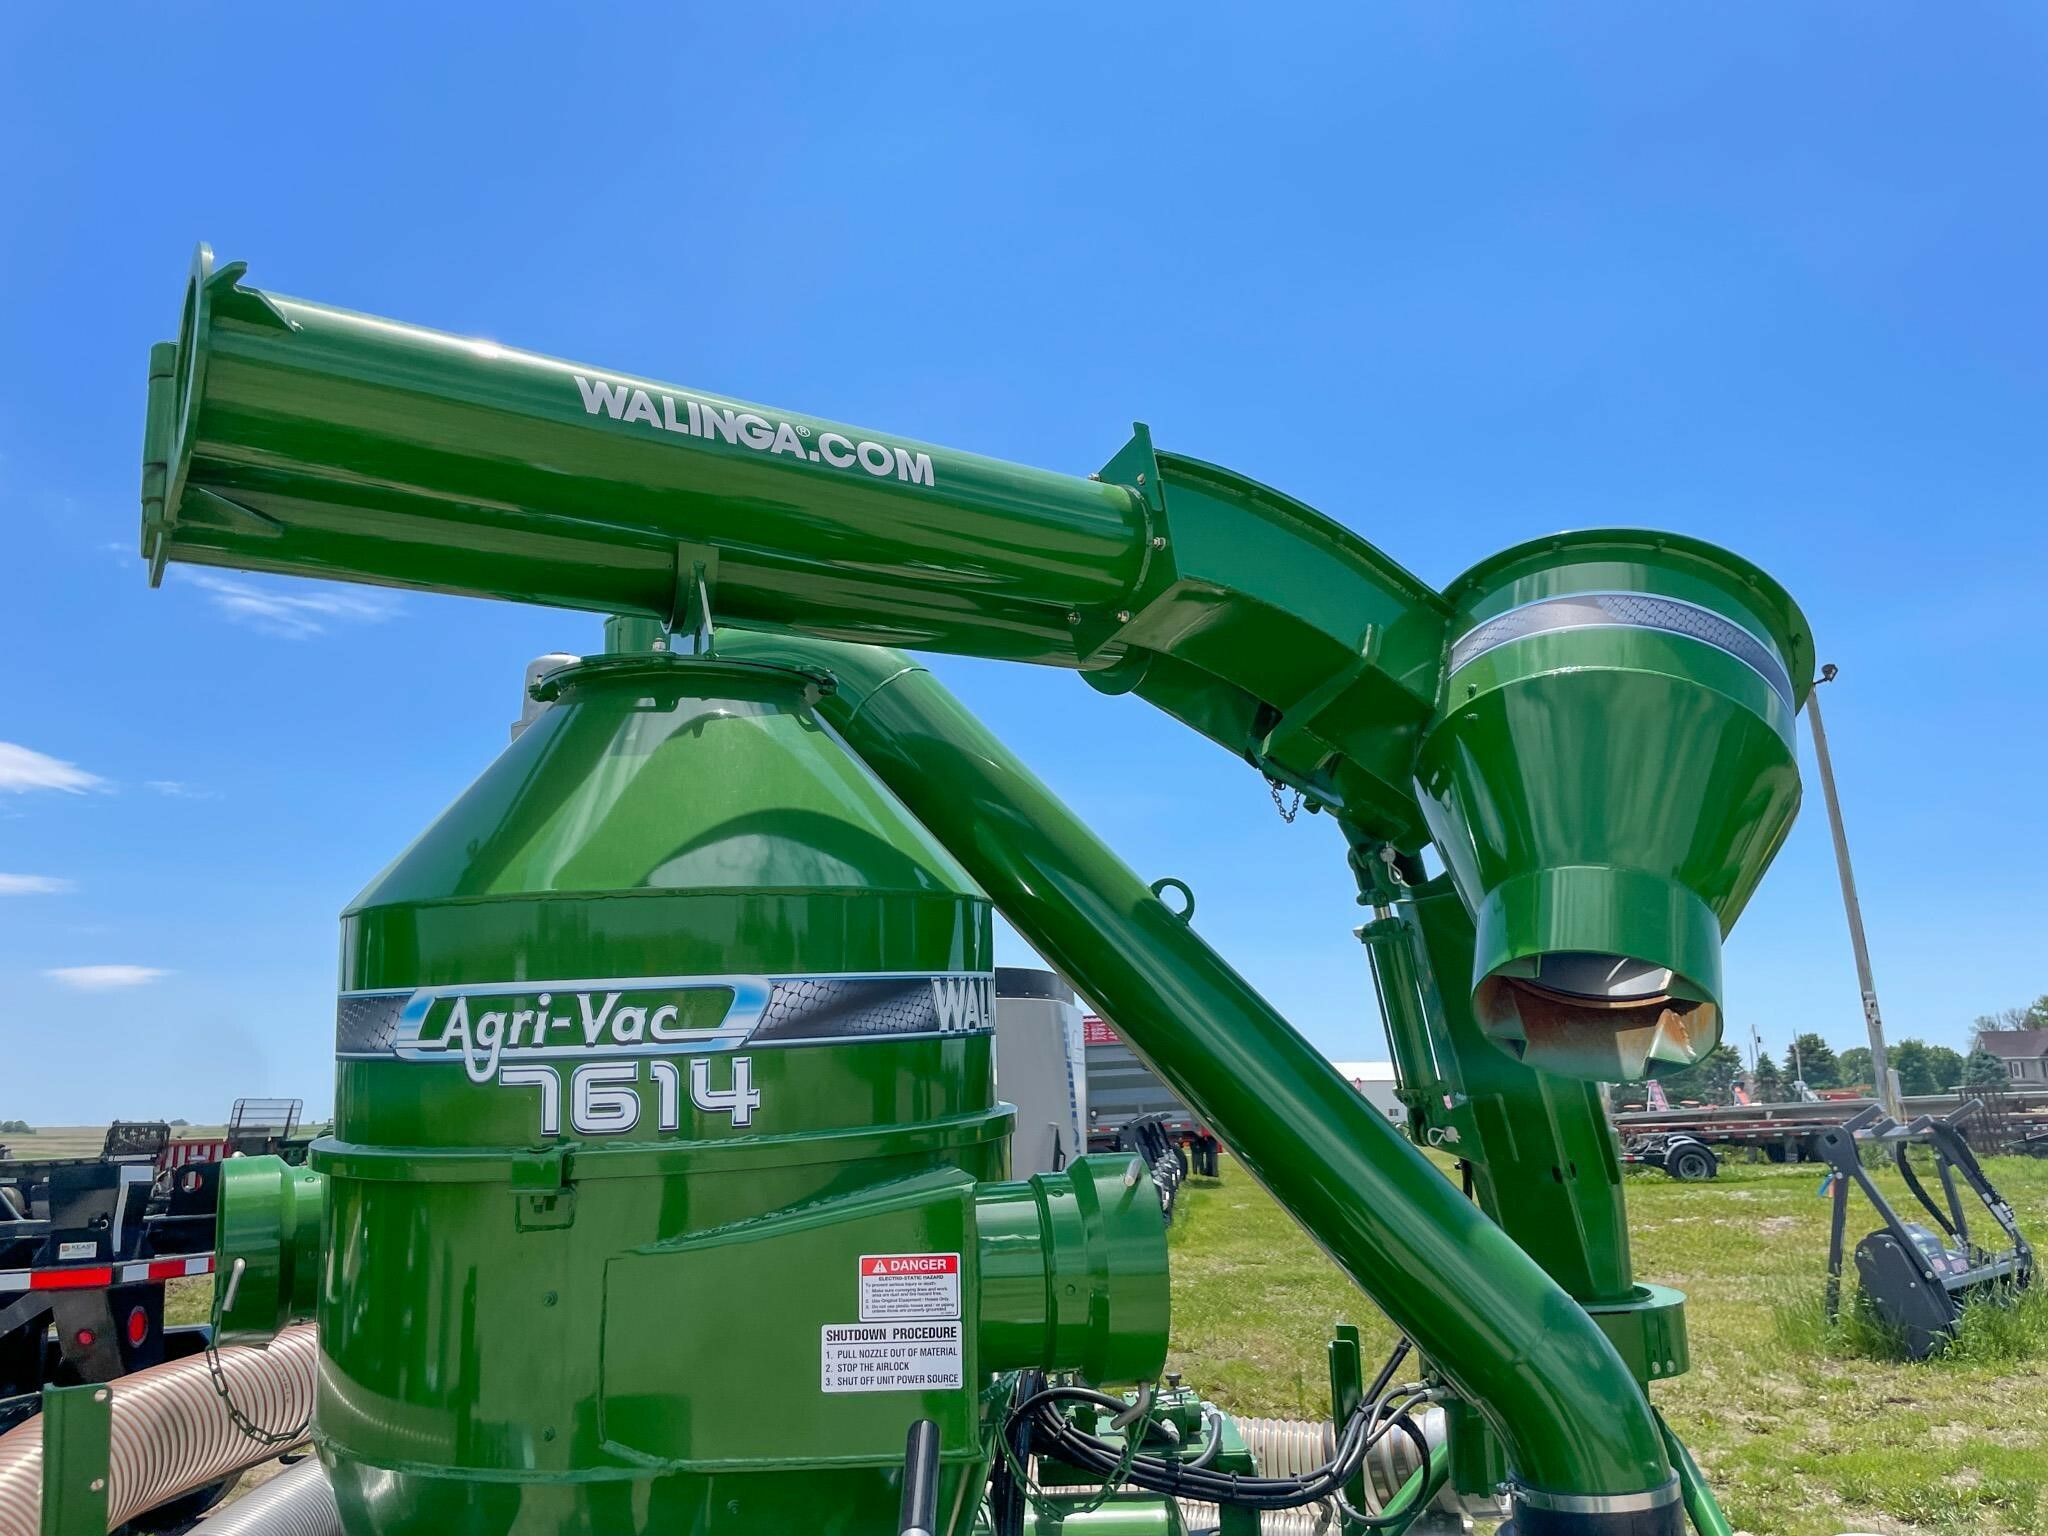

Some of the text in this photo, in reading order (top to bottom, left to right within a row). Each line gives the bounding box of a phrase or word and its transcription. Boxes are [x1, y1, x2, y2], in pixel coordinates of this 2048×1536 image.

[440, 992, 680, 1084] Agri-Vac
[499, 1056, 762, 1136] 7614
[891, 1259, 946, 1271] DANGER
[826, 1327, 957, 1342] SHUTDOWN PROCEDURE
[826, 1347, 957, 1359] 1. PULL NOZZLE OUT OF MATERIAL
[826, 1362, 909, 1373] 2. STOP THE AIRLOCK
[826, 1374, 958, 1386] 3. SHUT OFF UNIT POWER SOURCE
